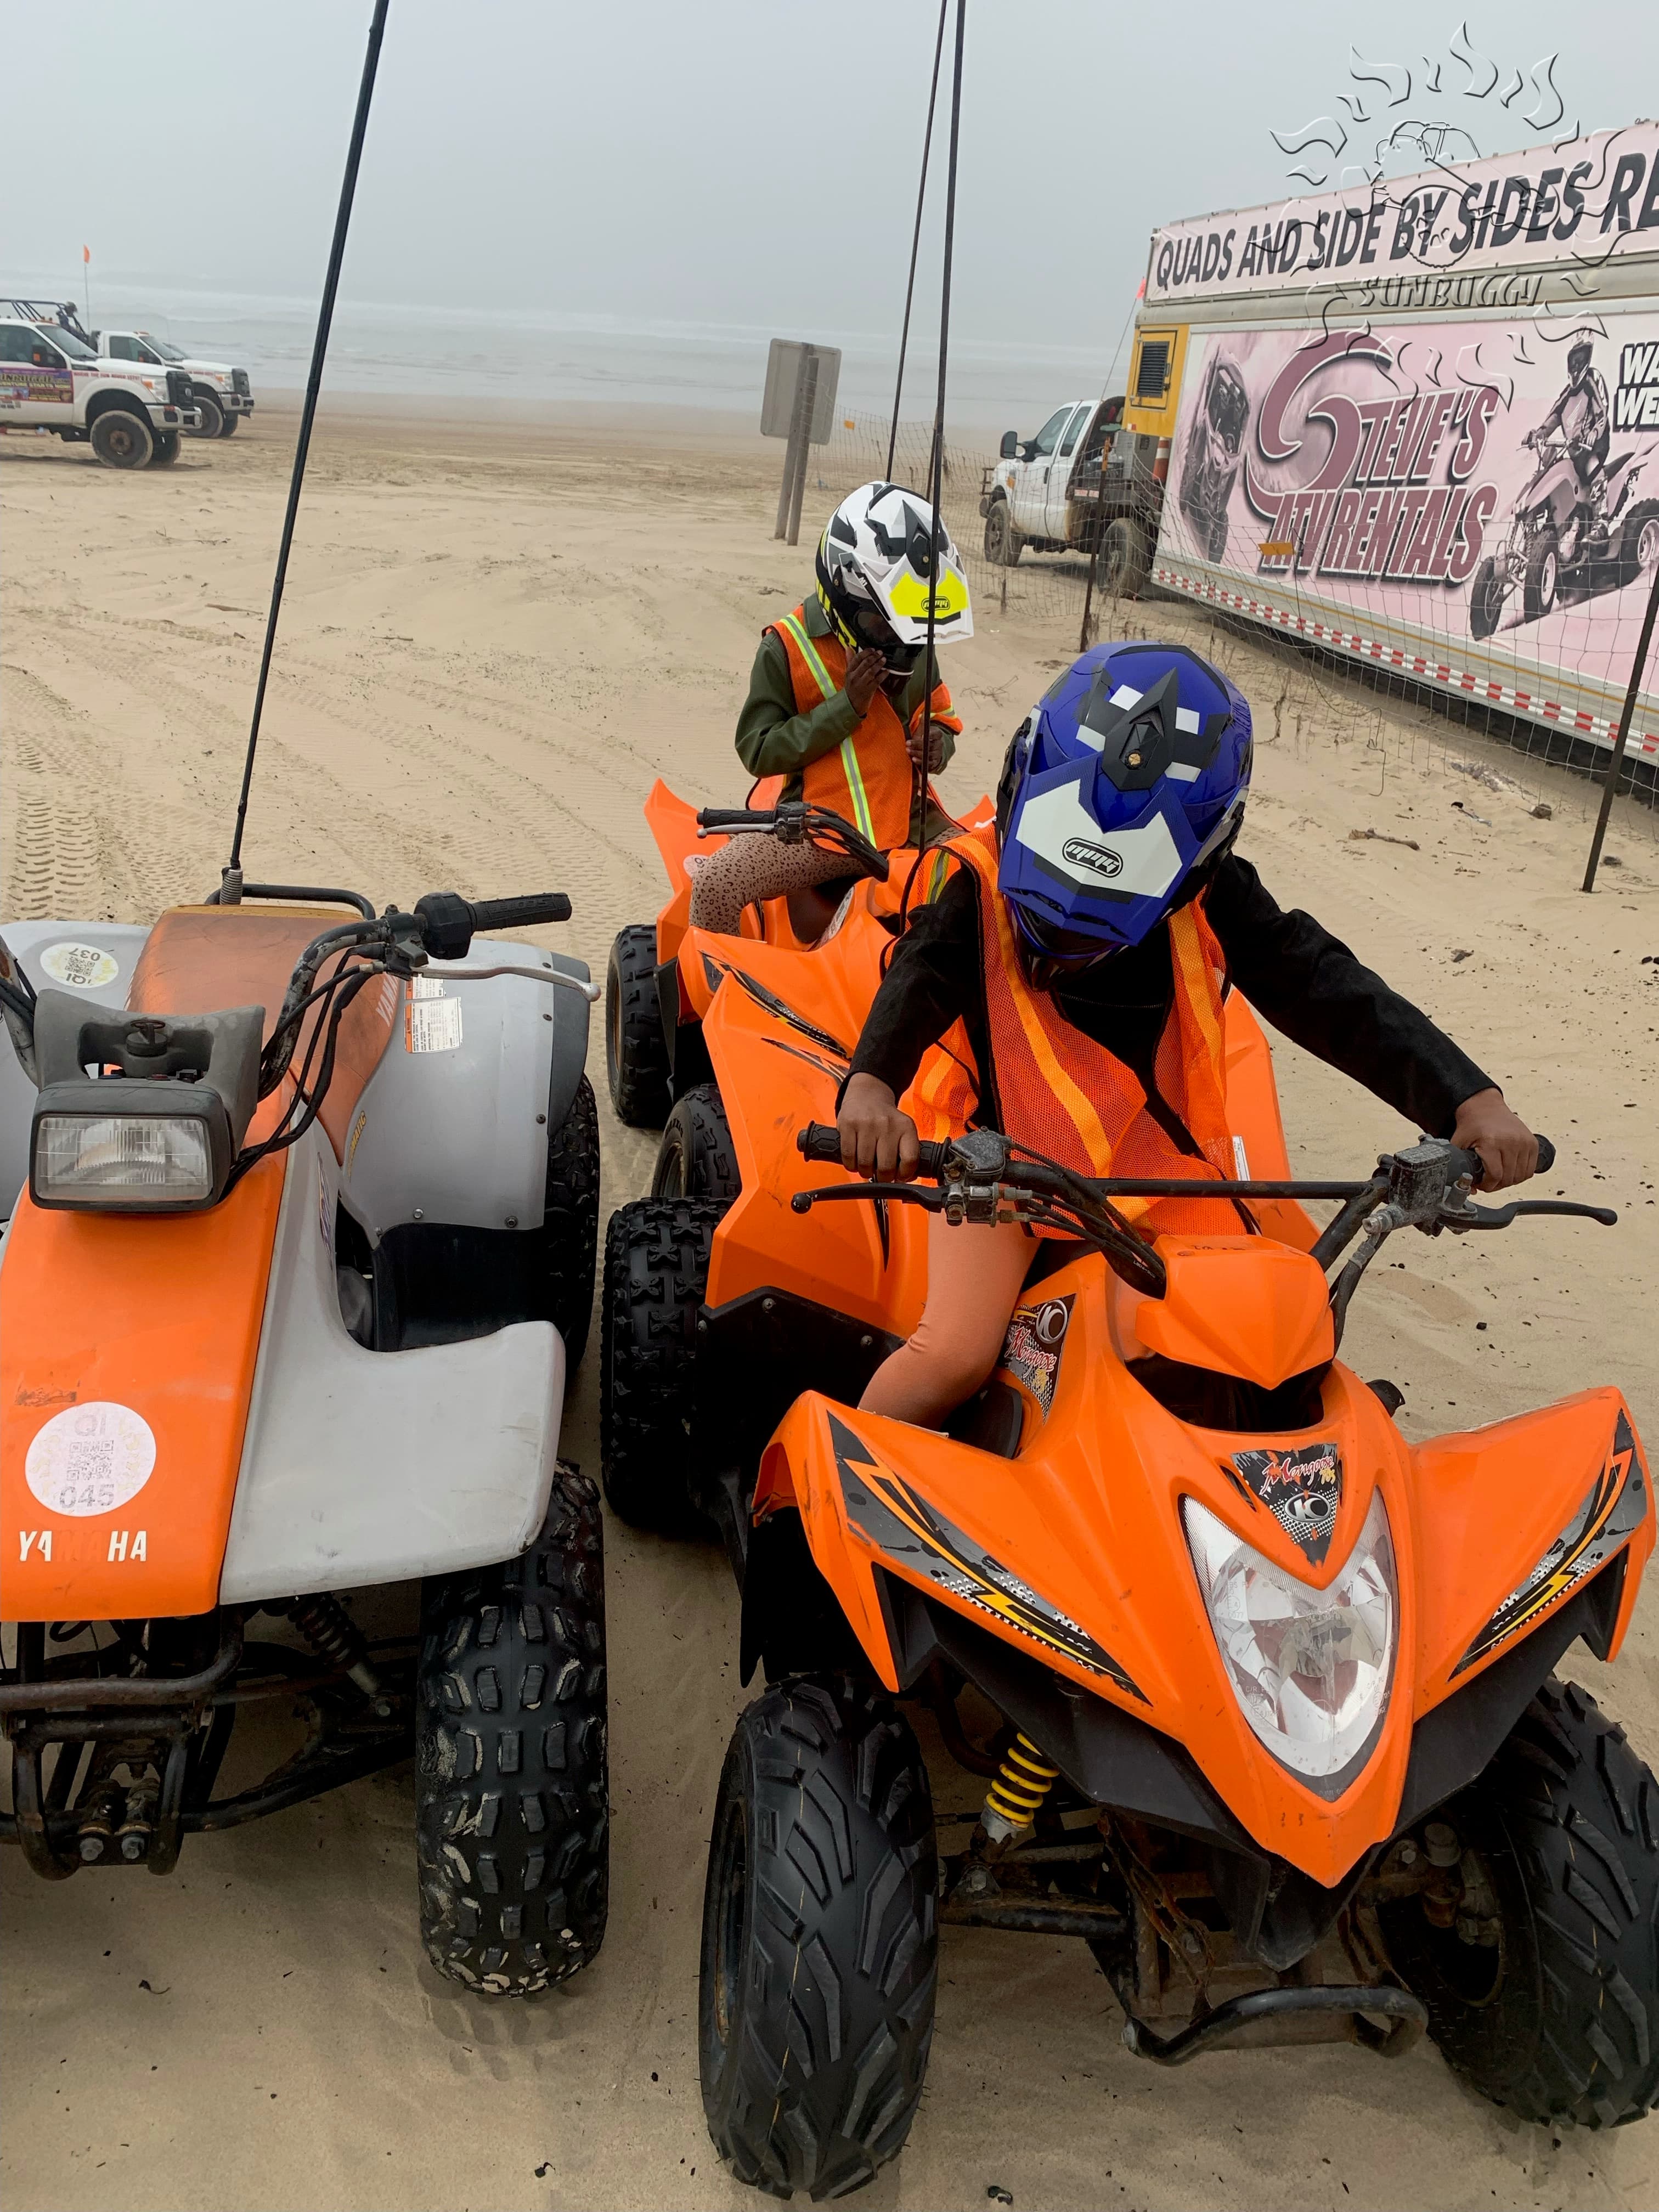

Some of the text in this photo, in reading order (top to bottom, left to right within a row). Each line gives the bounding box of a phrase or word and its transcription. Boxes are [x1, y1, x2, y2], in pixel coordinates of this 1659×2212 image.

[1157, 228, 1236, 290] QUADS
[1237, 218, 1302, 278] AND
[1307, 202, 1386, 271] SIDE
[1389, 189, 1451, 260] BY
[1449, 160, 1594, 254] SIDES
[1246, 329, 1500, 517] STEVE'S
[1261, 482, 1499, 583] ATV RENTALS
[69, 948, 100, 961] 037
[1004, 1325, 1058, 1379] Mongoose
[59, 1484, 115, 1509] 045
